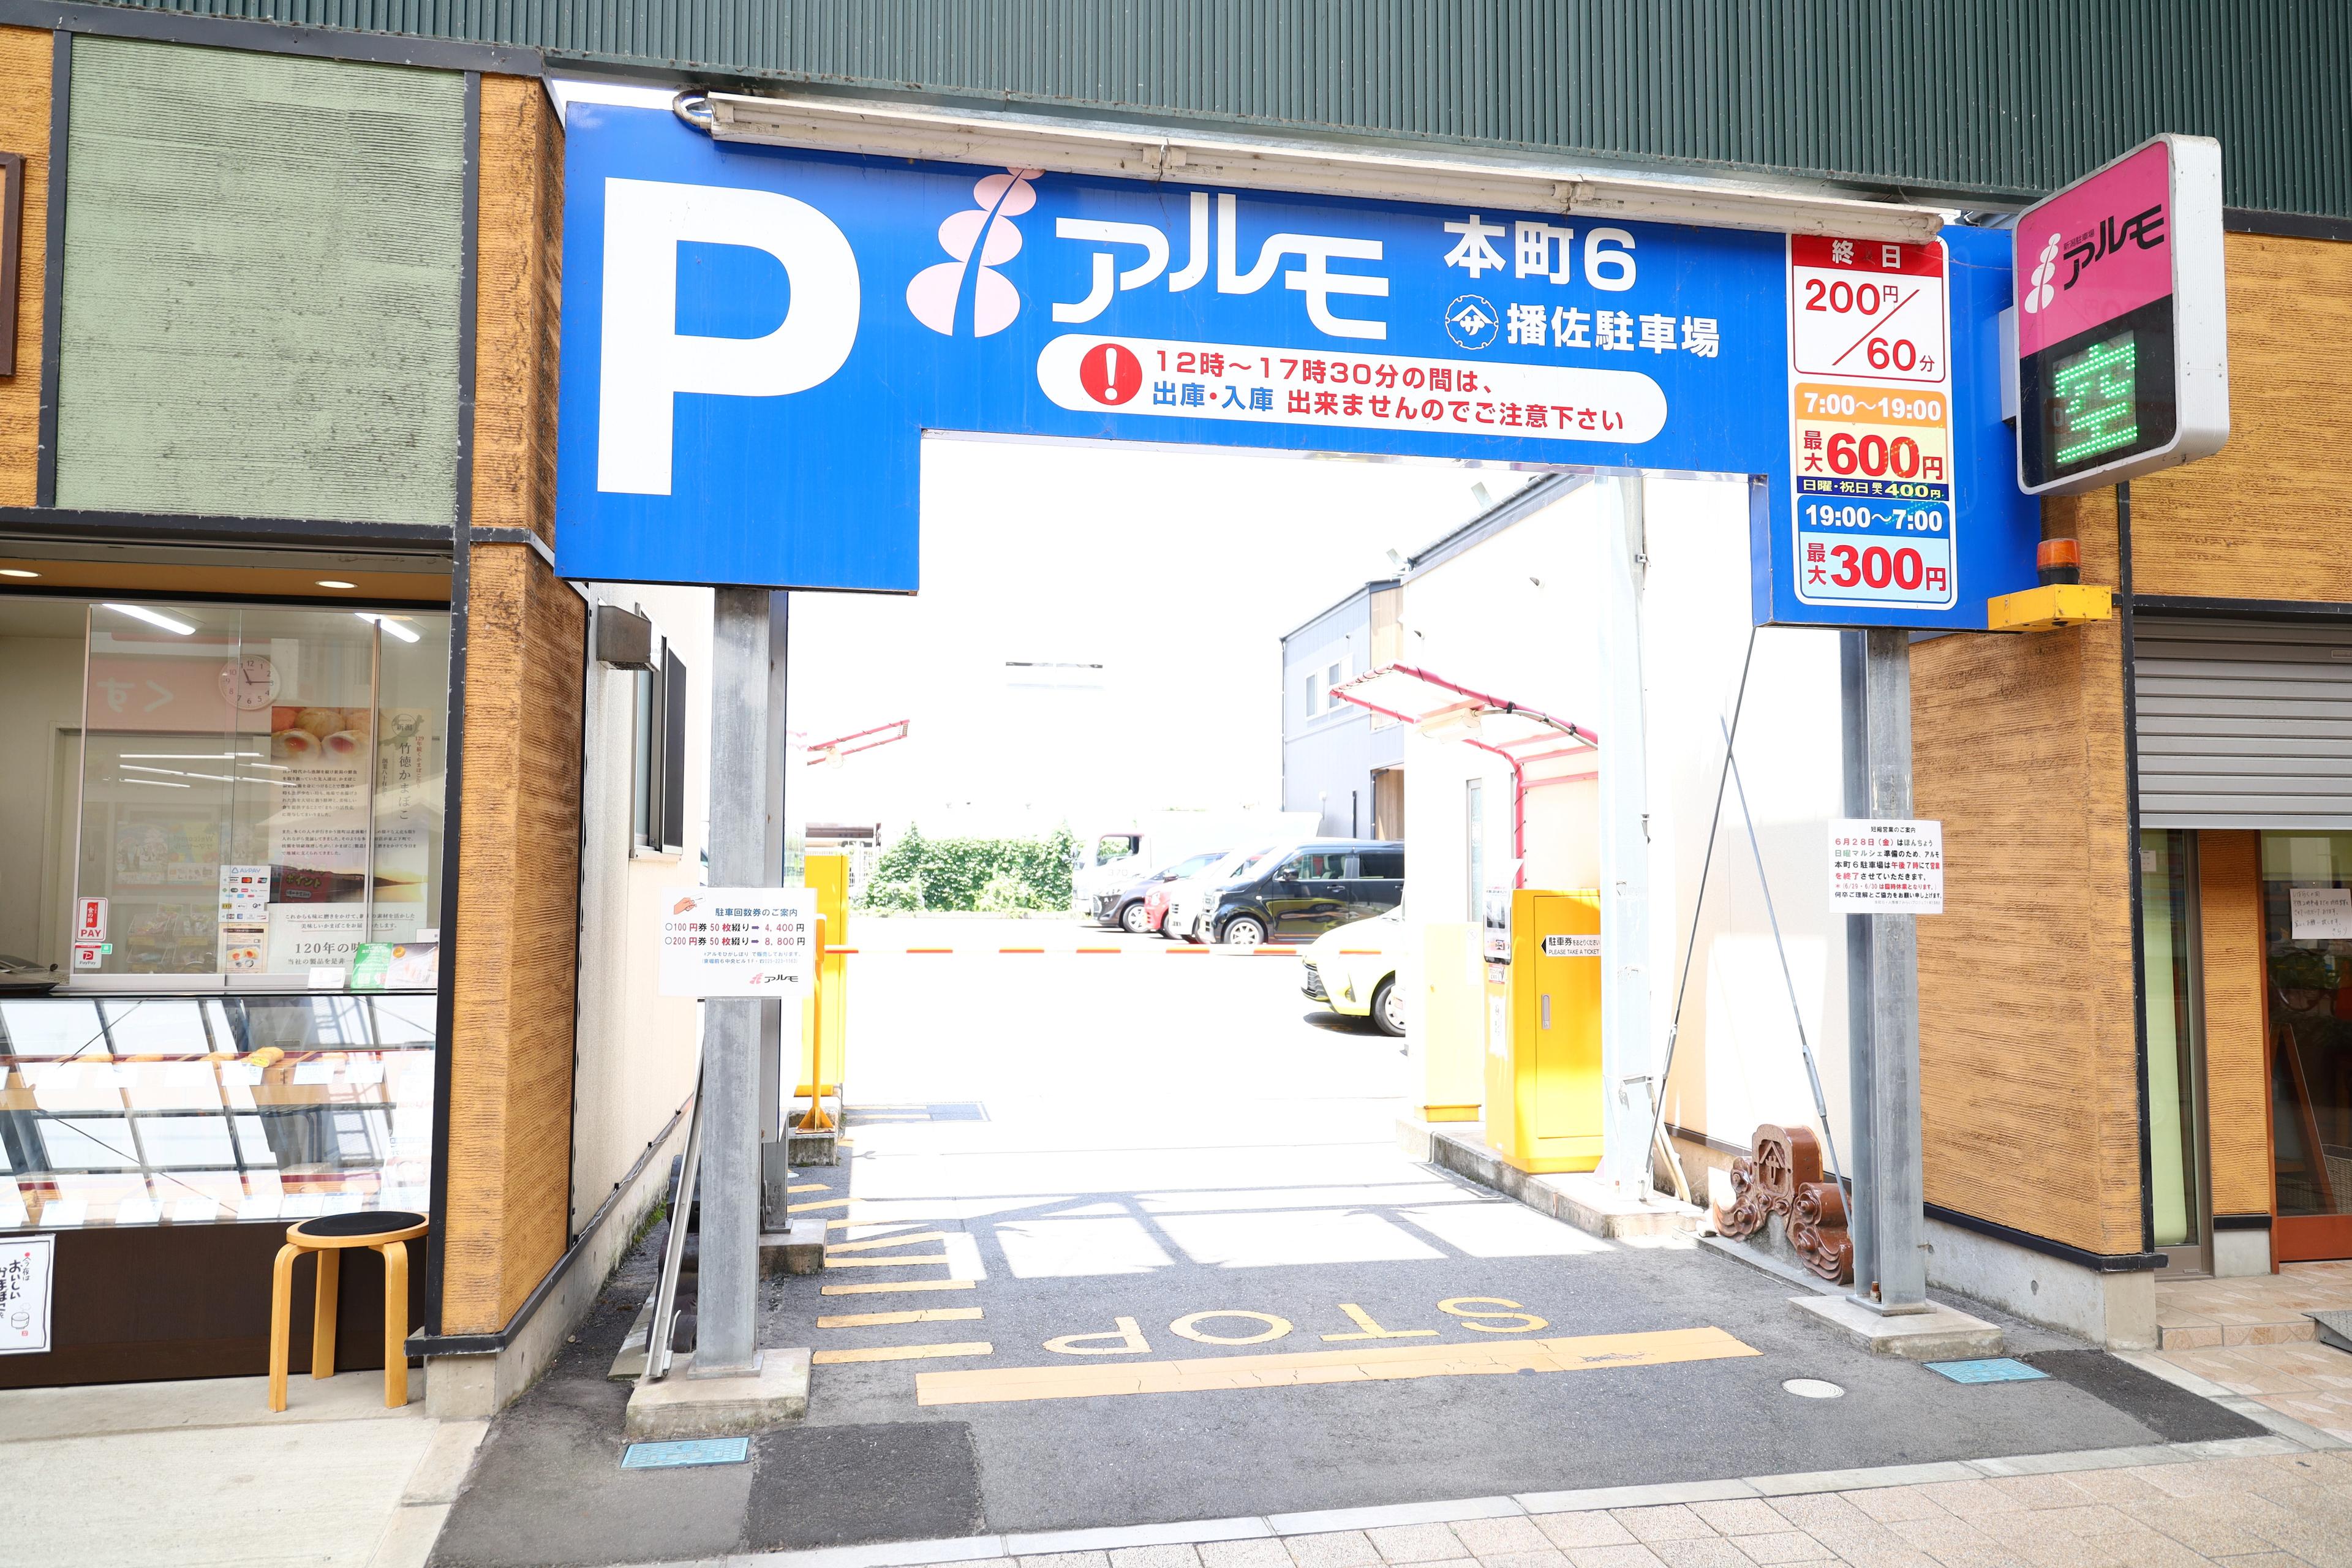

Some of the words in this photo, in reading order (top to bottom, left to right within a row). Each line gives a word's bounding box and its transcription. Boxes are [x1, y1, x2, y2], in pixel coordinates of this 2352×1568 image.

[1052, 192, 1389, 340] アルモ
[1443, 214, 1638, 292] 本町6
[1831, 239, 1901, 268] 終日
[2064, 204, 2165, 290] アルモ
[1805, 279, 1899, 315] 200円
[597, 177, 861, 496] P
[1506, 303, 1719, 358] 播佐駐車場
[1156, 350, 1492, 393] 12時〜17時30分の間は、
[1867, 337, 1935, 372] 60分
[1152, 382, 1273, 413] 出庫・入庫
[1287, 390, 1624, 432] 出来ませんのでご注意下さい
[1804, 392, 1941, 421] 7:00〜19:00
[2056, 344, 2138, 464] 空
[1804, 430, 1823, 472] 最大
[1826, 433, 1943, 480] 600円
[1803, 479, 1869, 494] 日曜・祝日
[1884, 484, 1941, 499] 400円
[1806, 505, 1943, 532] 19:00〜7:00
[1807, 543, 1826, 586] 最大
[1830, 545, 1946, 592] 300円
[399, 742, 411, 820] 竹徳かまぼこ
[715, 908, 797, 917] 駐車回数券のご案内
[9, 1260, 23, 1300] おいしい
[1042, 1297, 1548, 1355] STOP
